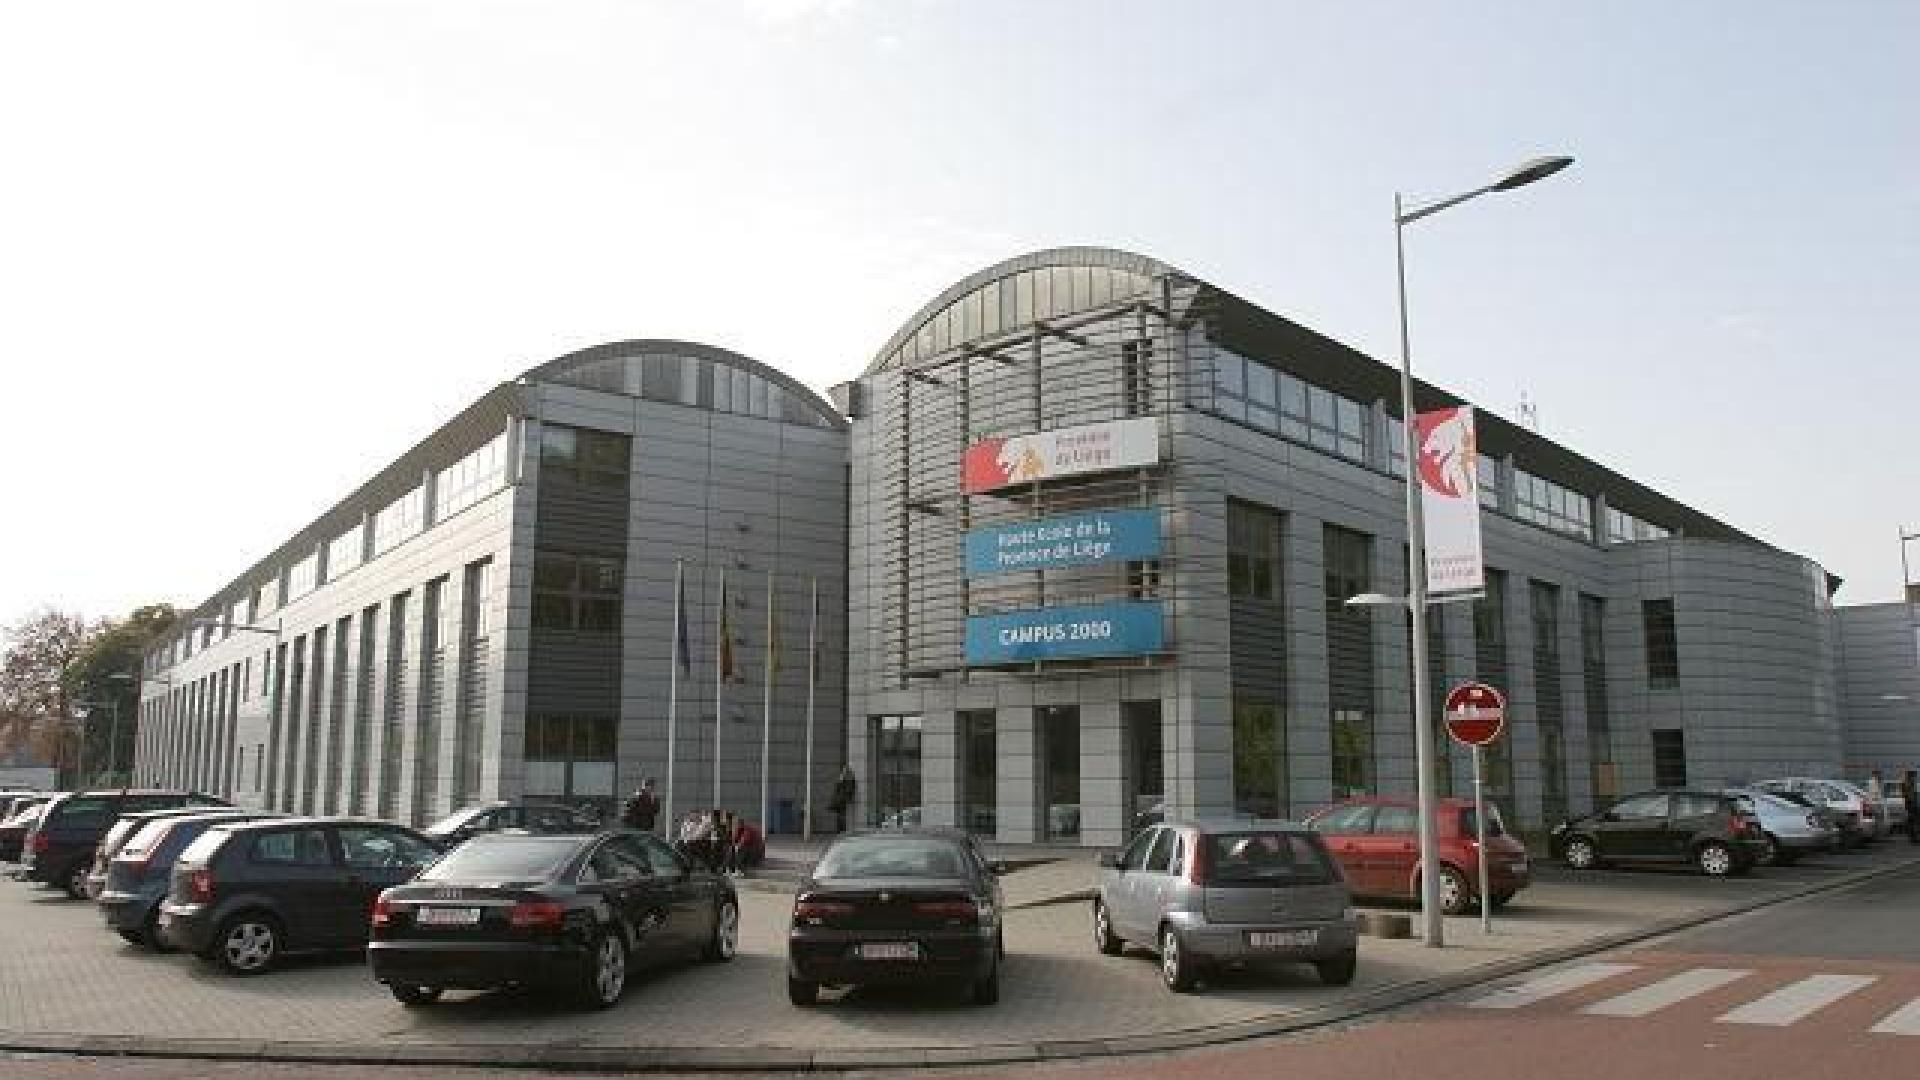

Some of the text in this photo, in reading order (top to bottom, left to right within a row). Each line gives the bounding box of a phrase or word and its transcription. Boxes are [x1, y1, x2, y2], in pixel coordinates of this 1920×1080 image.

[1076, 521, 1093, 537] de
[1097, 518, 1111, 535] la
[1053, 544, 1069, 559] de
[999, 620, 1111, 646] CAMPUS 2000
